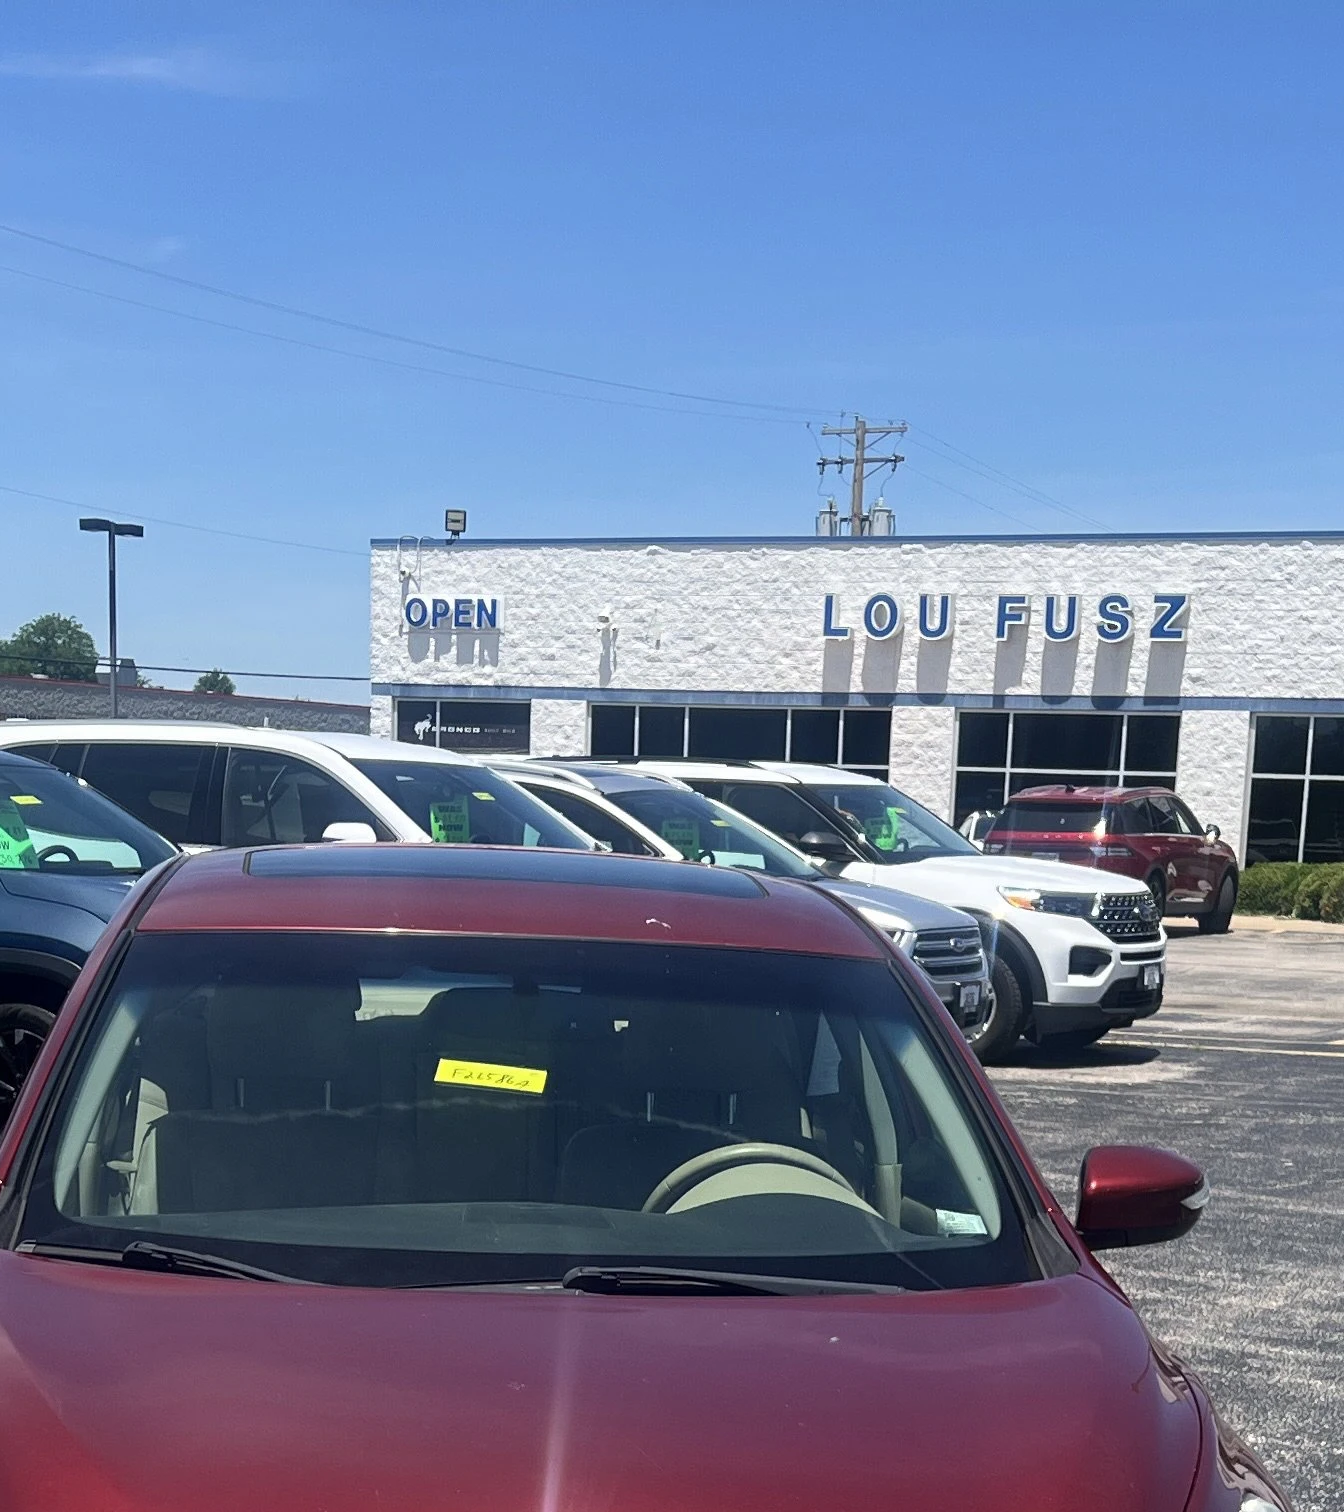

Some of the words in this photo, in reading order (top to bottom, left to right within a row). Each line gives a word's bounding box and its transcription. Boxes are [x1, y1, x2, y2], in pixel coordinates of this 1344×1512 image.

[405, 597, 497, 628] OPEN
[822, 592, 953, 641] LOU
[995, 592, 1187, 642] FUSZ
